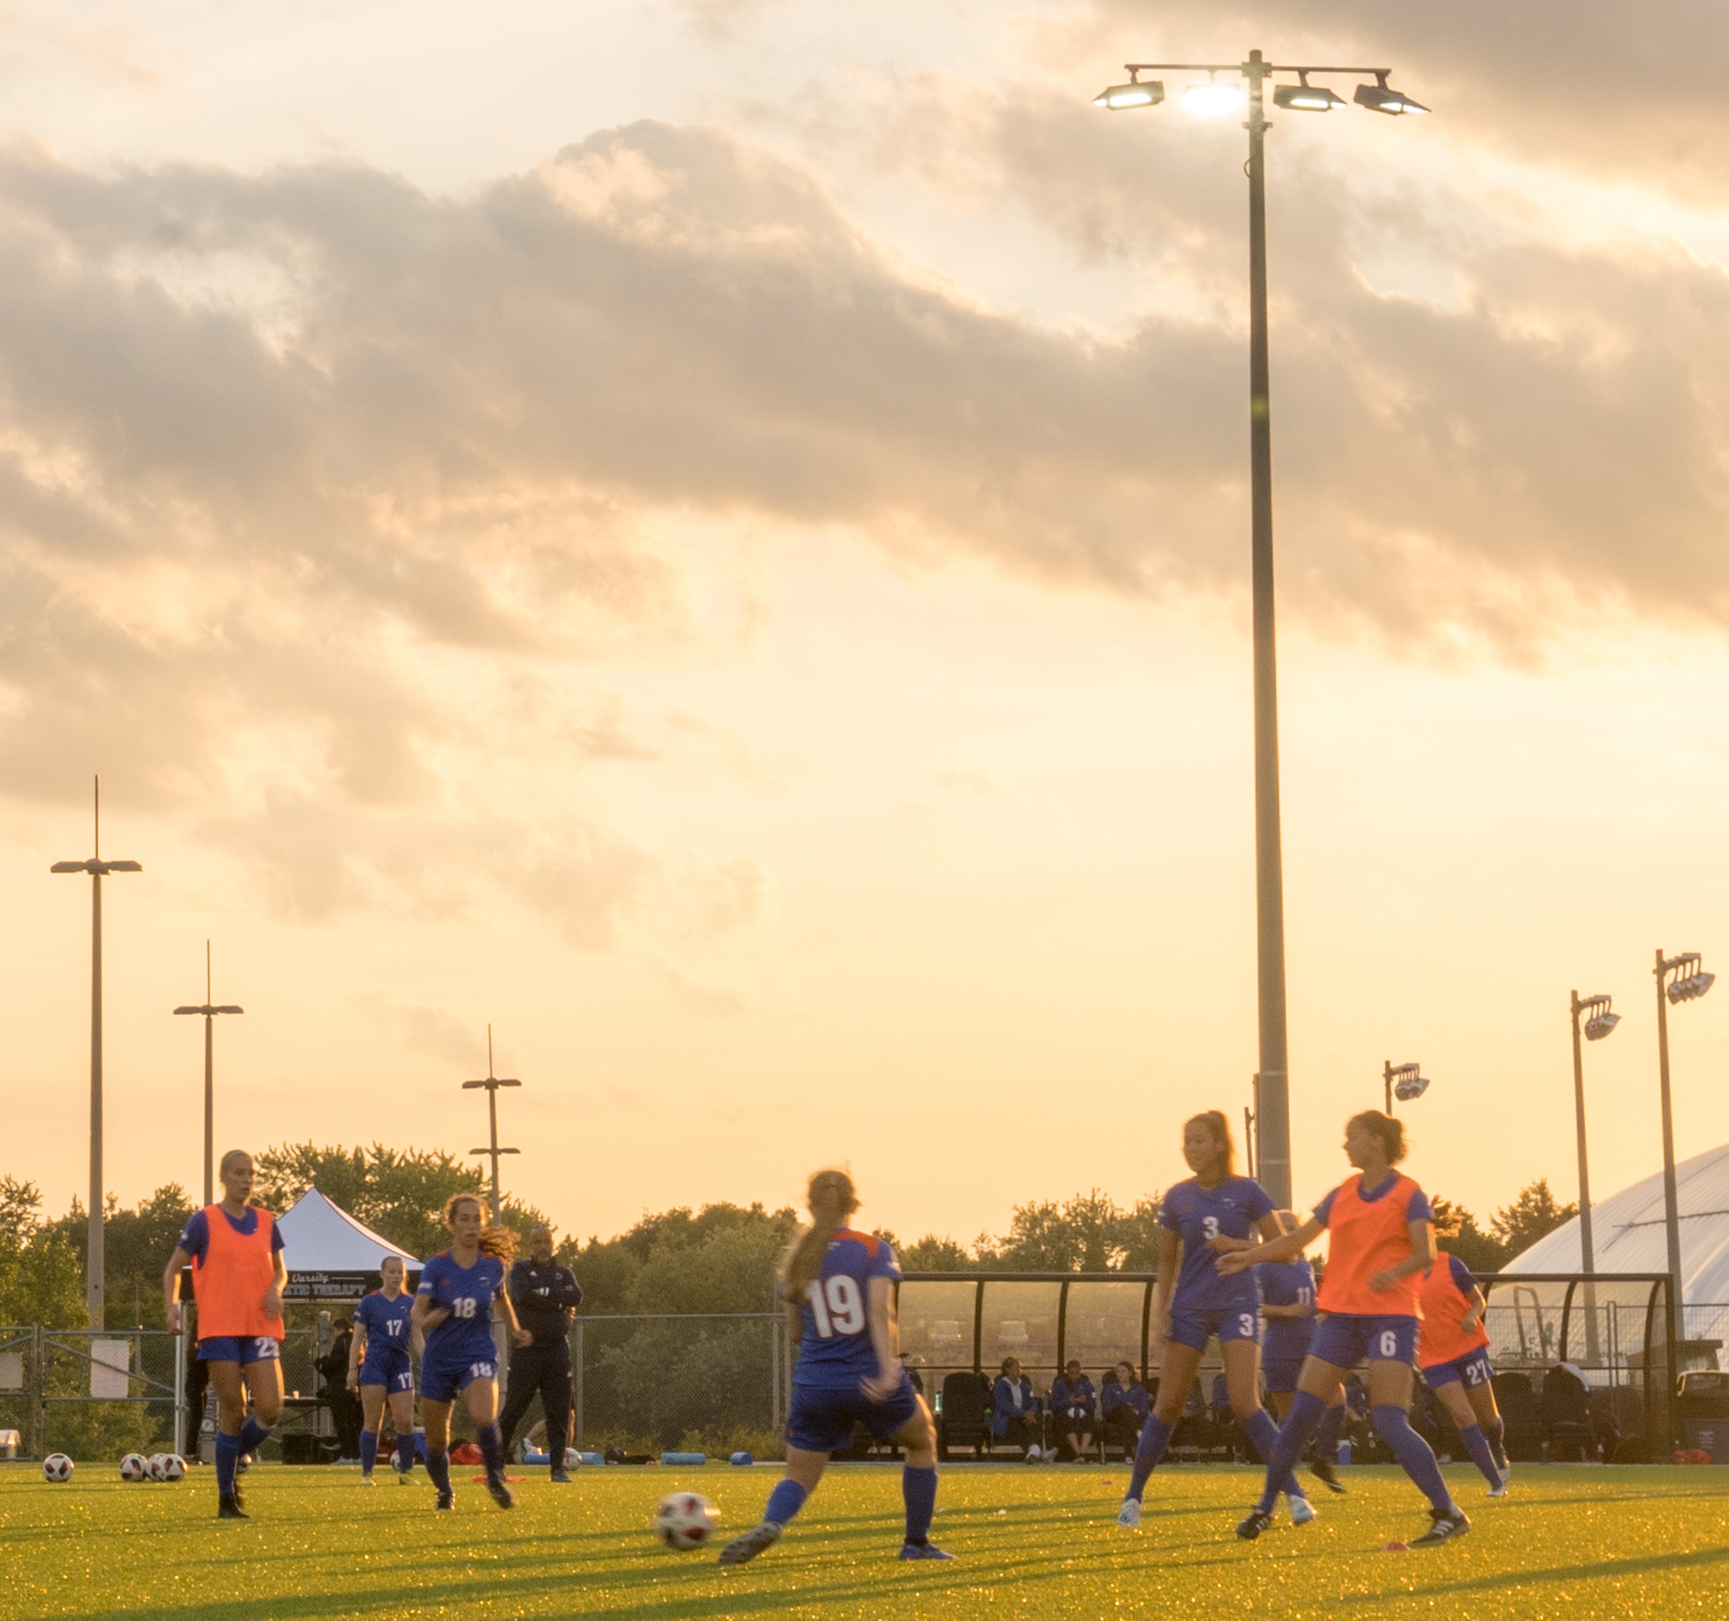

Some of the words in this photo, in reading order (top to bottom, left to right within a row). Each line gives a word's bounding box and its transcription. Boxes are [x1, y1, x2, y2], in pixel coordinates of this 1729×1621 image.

[1203, 1216, 1219, 1240] 3
[291, 1272, 329, 1284] Varsity
[453, 1297, 476, 1318] 18
[804, 1274, 865, 1338] 19
[386, 1319, 403, 1336] 17
[1239, 1313, 1254, 1337] 3
[1380, 1330, 1397, 1357] 6
[398, 1372, 413, 1389] 17
[470, 1362, 493, 1378] 18
[1466, 1359, 1489, 1386] 27
